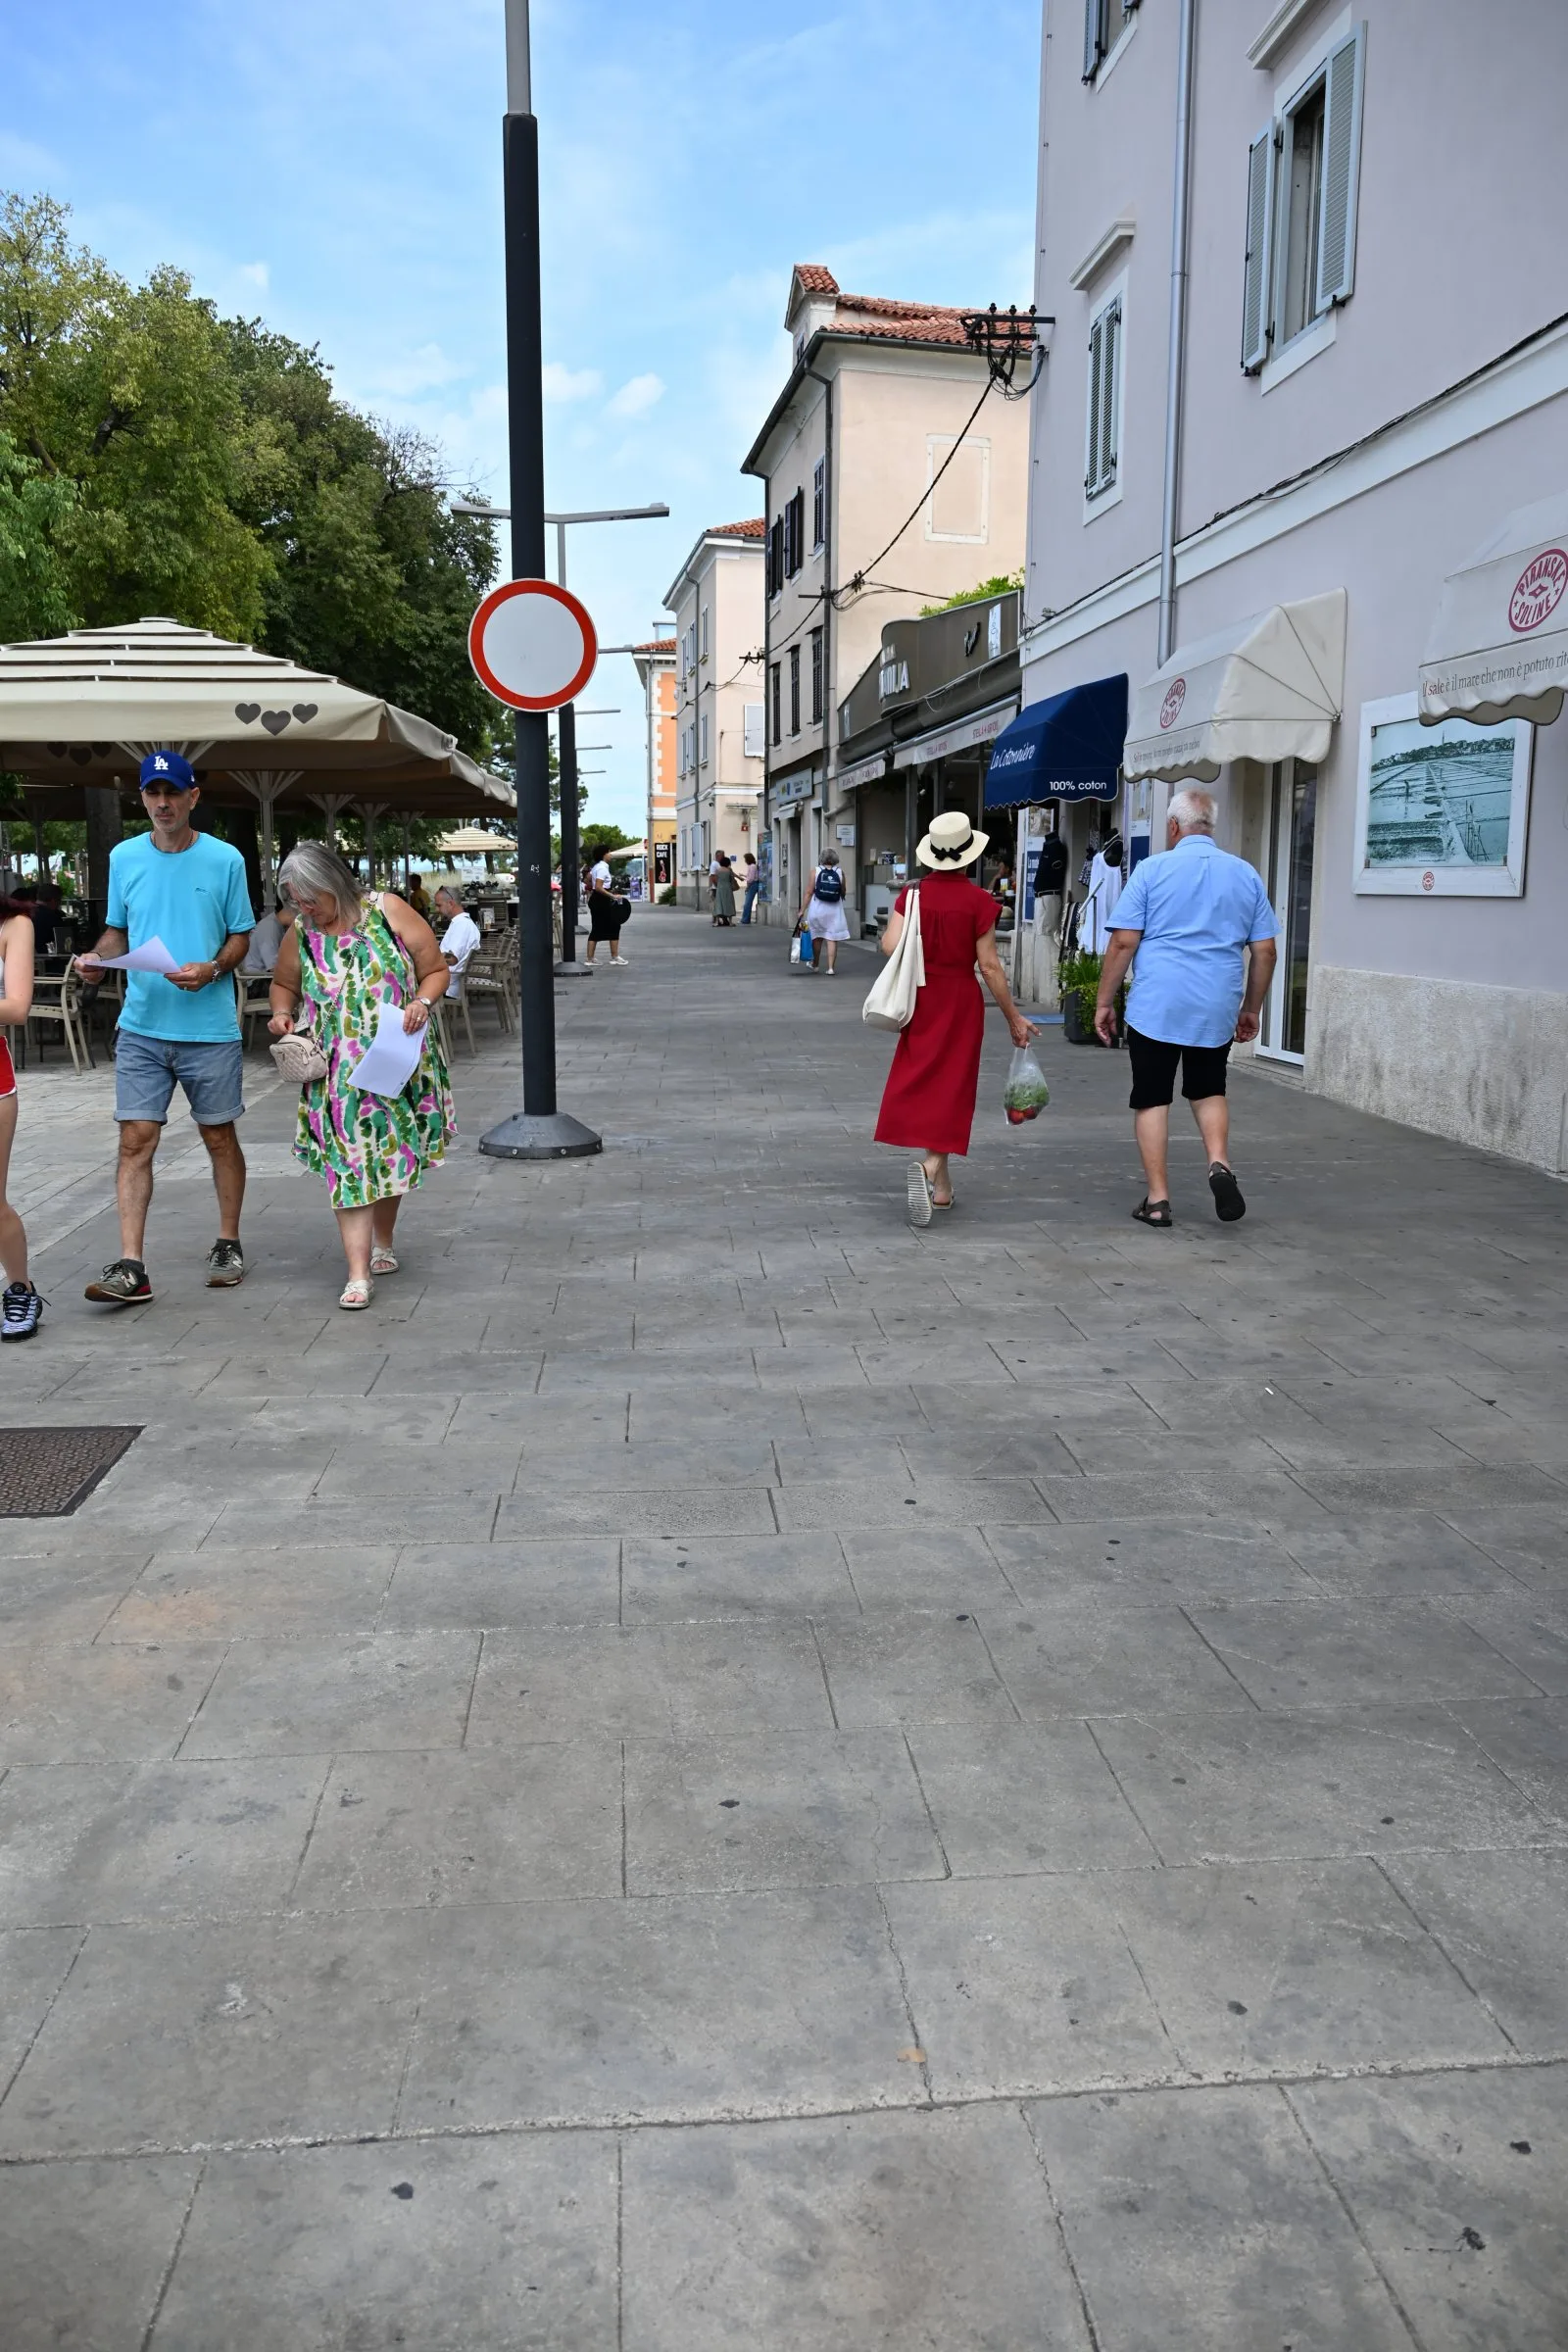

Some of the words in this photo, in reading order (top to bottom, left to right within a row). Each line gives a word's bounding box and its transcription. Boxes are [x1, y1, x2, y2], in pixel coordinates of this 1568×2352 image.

[1518, 556, 1567, 596] PIRANSKE
[1514, 593, 1551, 625] SOLINE
[1428, 677, 1445, 697] sale
[1458, 674, 1480, 690] mare
[1481, 666, 1497, 685] che
[1497, 666, 1515, 683] non
[1523, 656, 1555, 681] potuto
[154, 756, 169, 770] LA
[1050, 781, 1075, 791] 100%
[1078, 780, 1106, 791] coton
